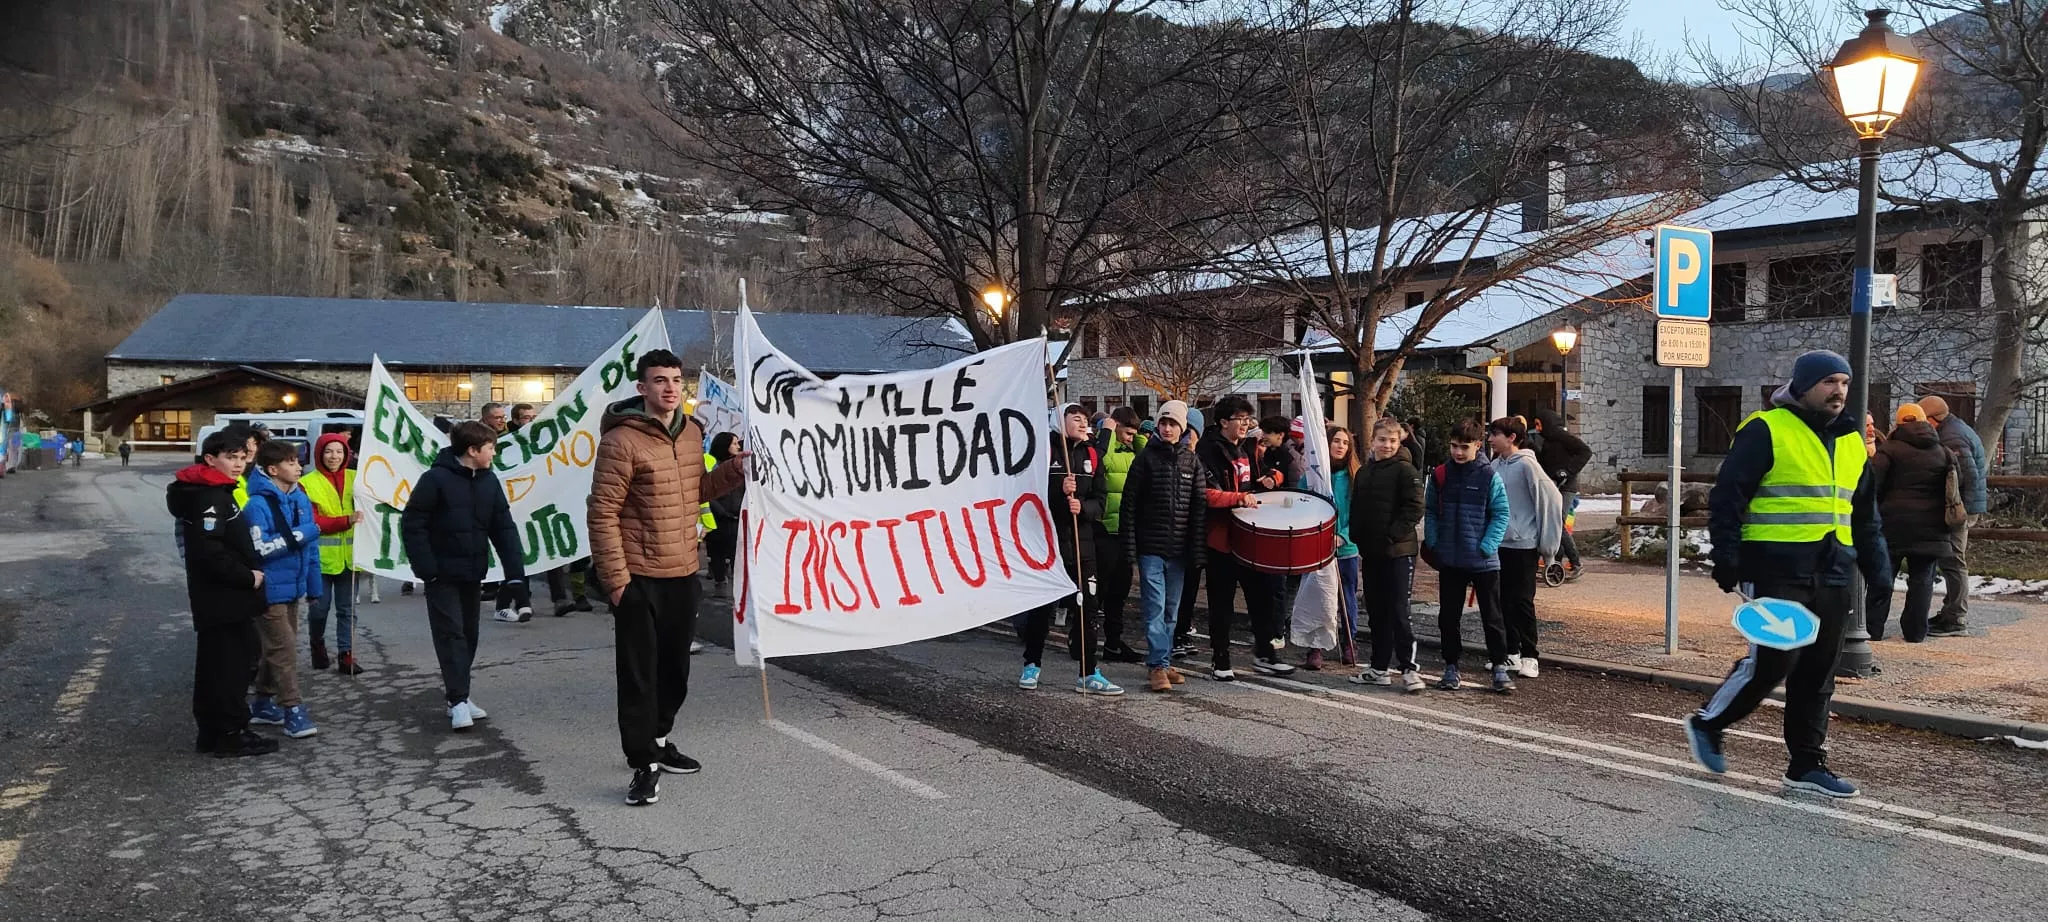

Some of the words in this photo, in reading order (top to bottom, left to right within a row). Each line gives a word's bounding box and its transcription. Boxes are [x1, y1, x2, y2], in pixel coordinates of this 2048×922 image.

[1668, 238, 1701, 308] P
[1660, 325, 1685, 335] EXCEPTO
[1686, 327, 1707, 336] MARTES
[1664, 352, 1675, 360] POR
[1676, 352, 1703, 361] MERCADO
[373, 384, 589, 471] EDUCION
[600, 333, 639, 394] DE
[546, 430, 596, 476] NO
[780, 407, 1037, 500] COMUNIDAD
[774, 492, 1057, 615] INSTITUTO
